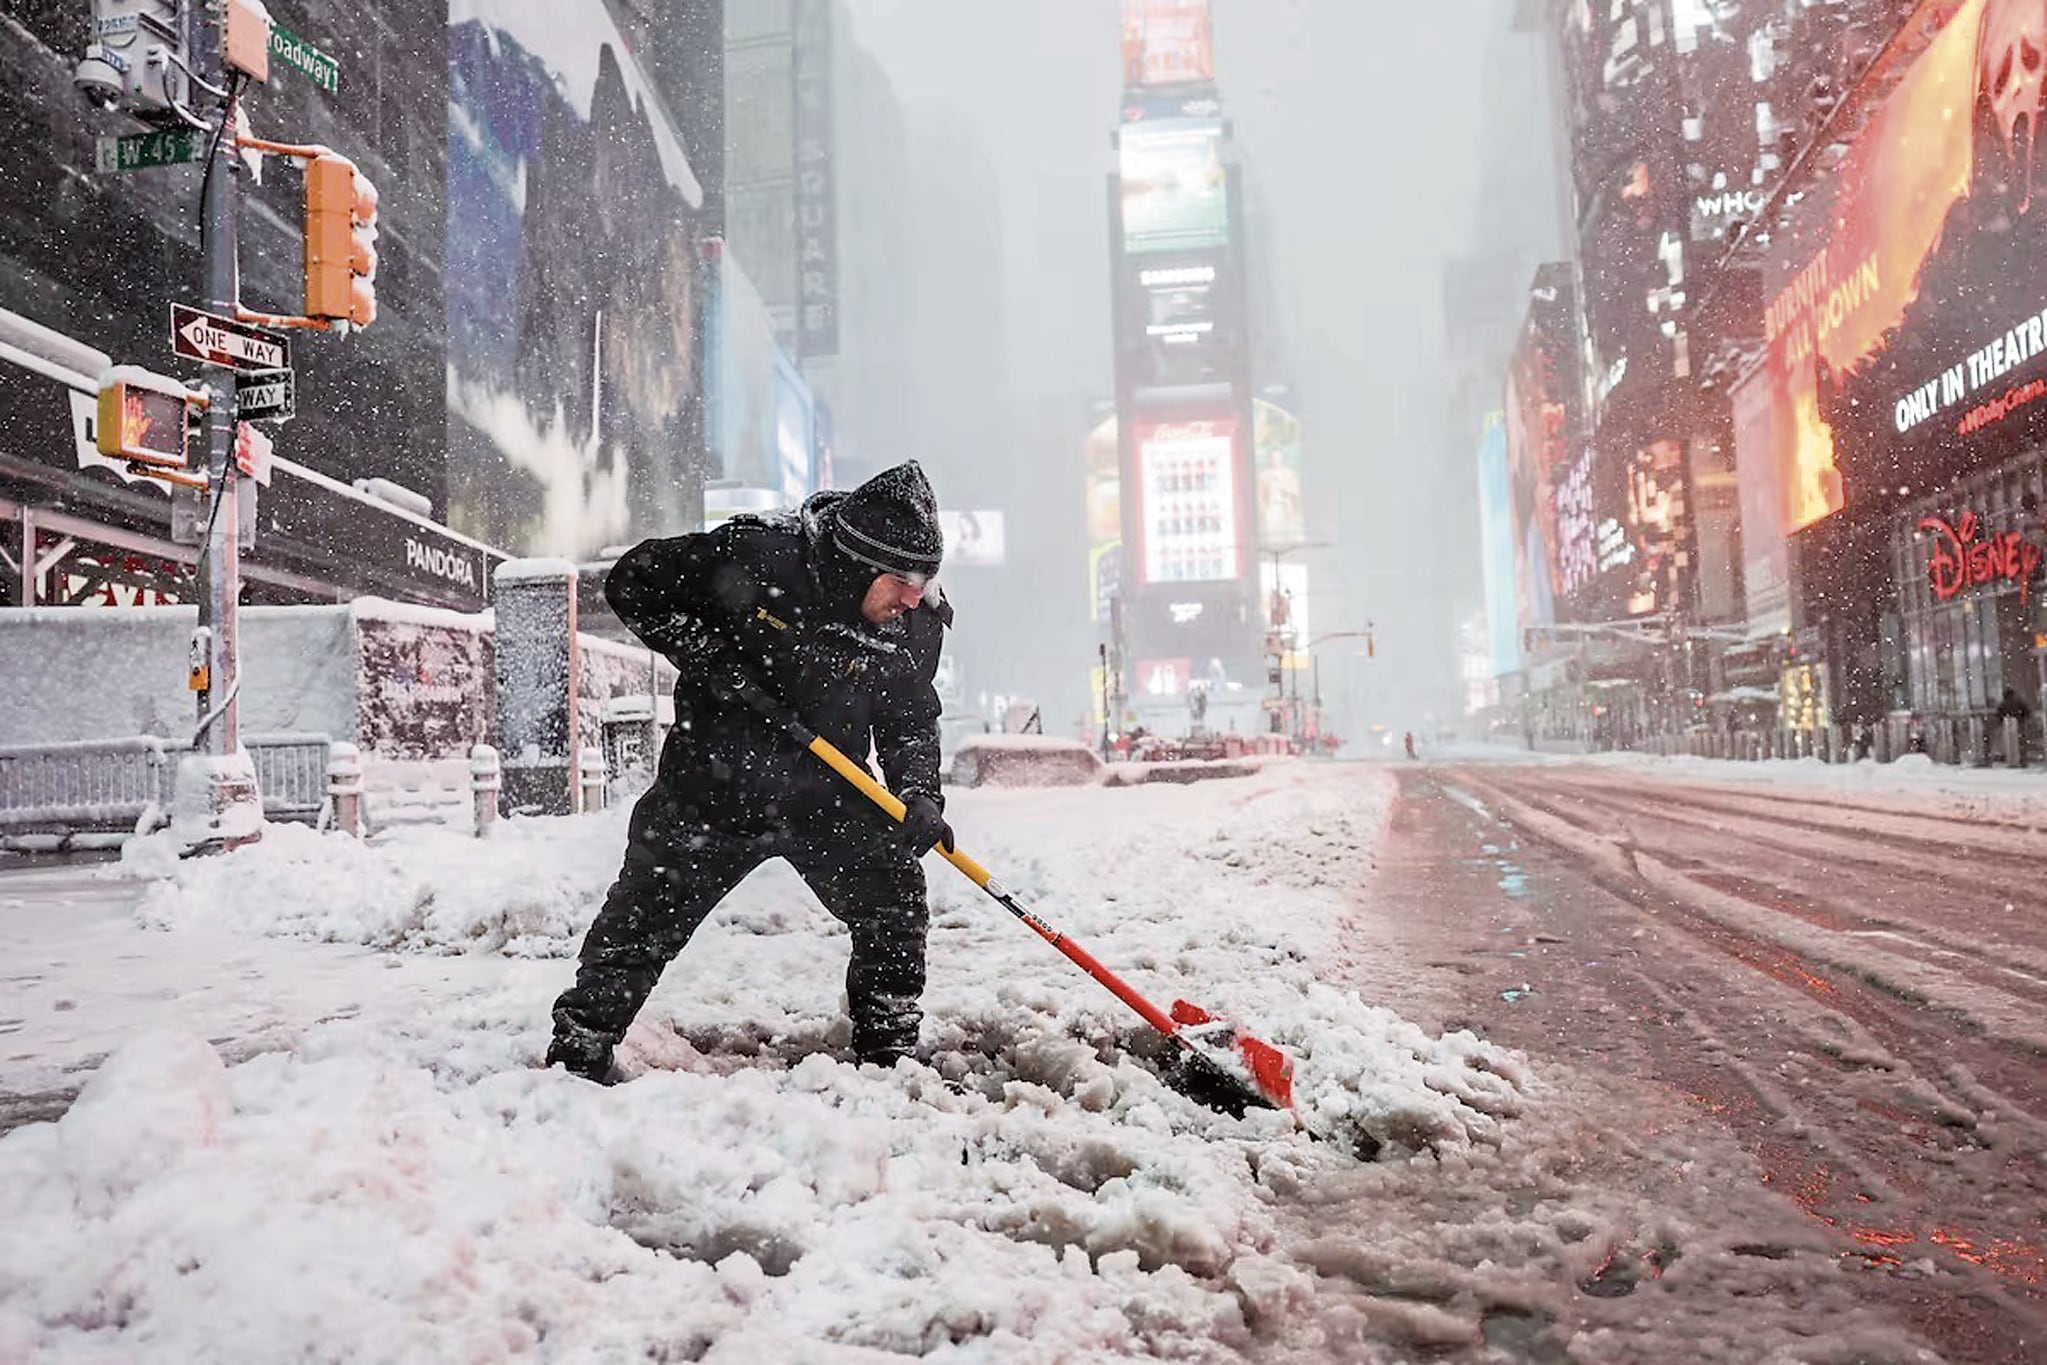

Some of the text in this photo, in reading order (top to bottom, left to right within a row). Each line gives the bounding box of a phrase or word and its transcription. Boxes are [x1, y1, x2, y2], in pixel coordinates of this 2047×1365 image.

[267, 30, 331, 89] roadway
[122, 140, 141, 165] W
[152, 134, 176, 162] 45
[1817, 252, 1880, 340] DOWN
[193, 326, 276, 362] ONE WAY
[240, 386, 276, 408] WAY
[1895, 378, 1939, 433] ONLY
[1941, 363, 1964, 406] IN
[405, 537, 475, 588] PANDORA
